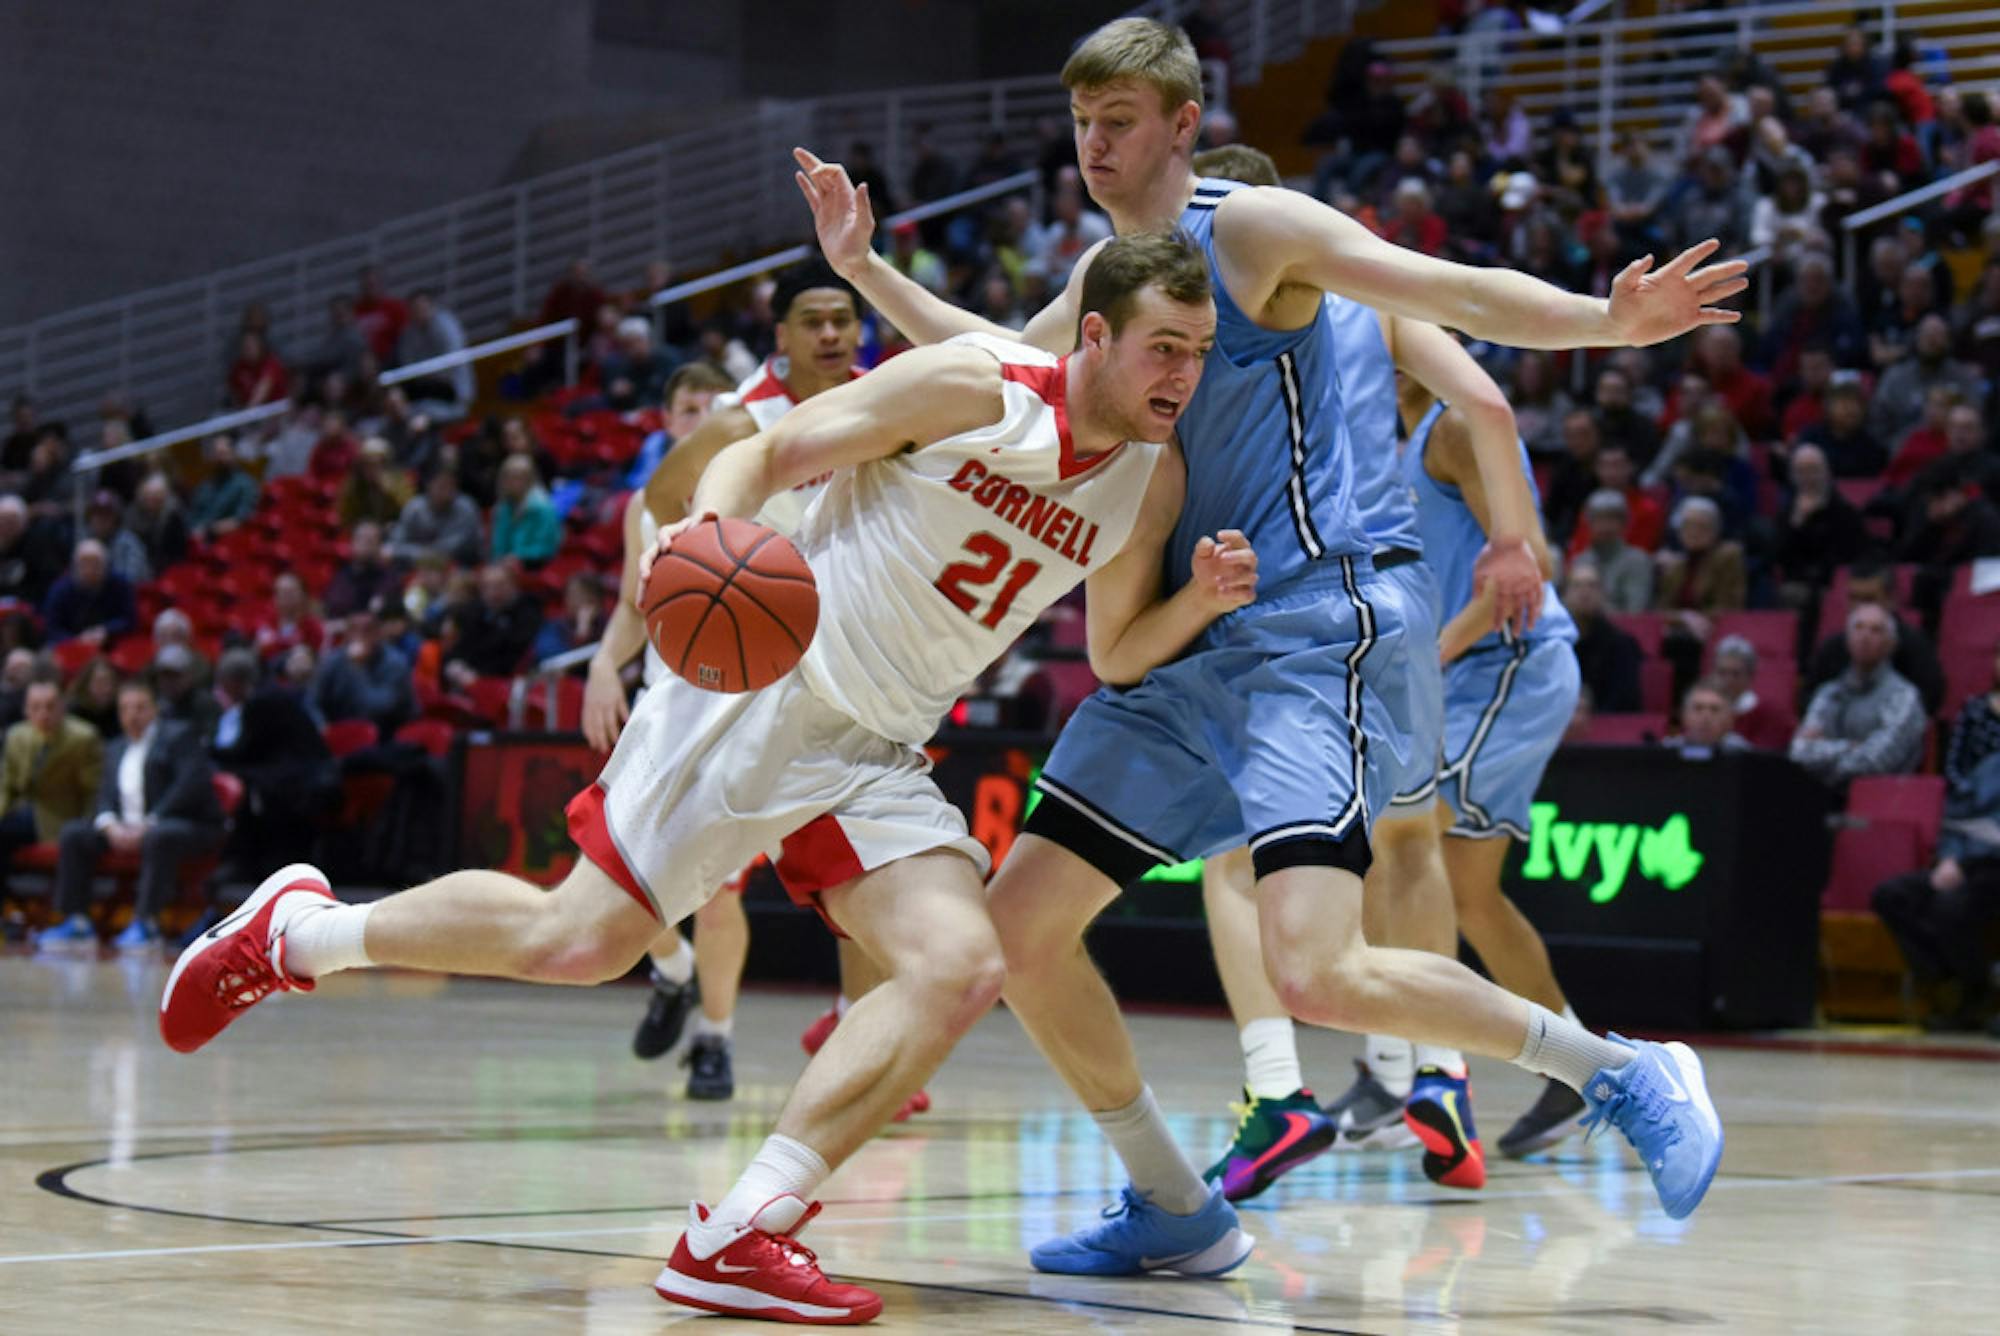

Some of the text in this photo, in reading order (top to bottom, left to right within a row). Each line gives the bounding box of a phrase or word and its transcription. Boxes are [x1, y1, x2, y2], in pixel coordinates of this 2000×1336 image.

[948, 458, 1099, 568] CORNELL
[933, 529, 1043, 631] 21
[1520, 801, 1640, 904] Ivy
